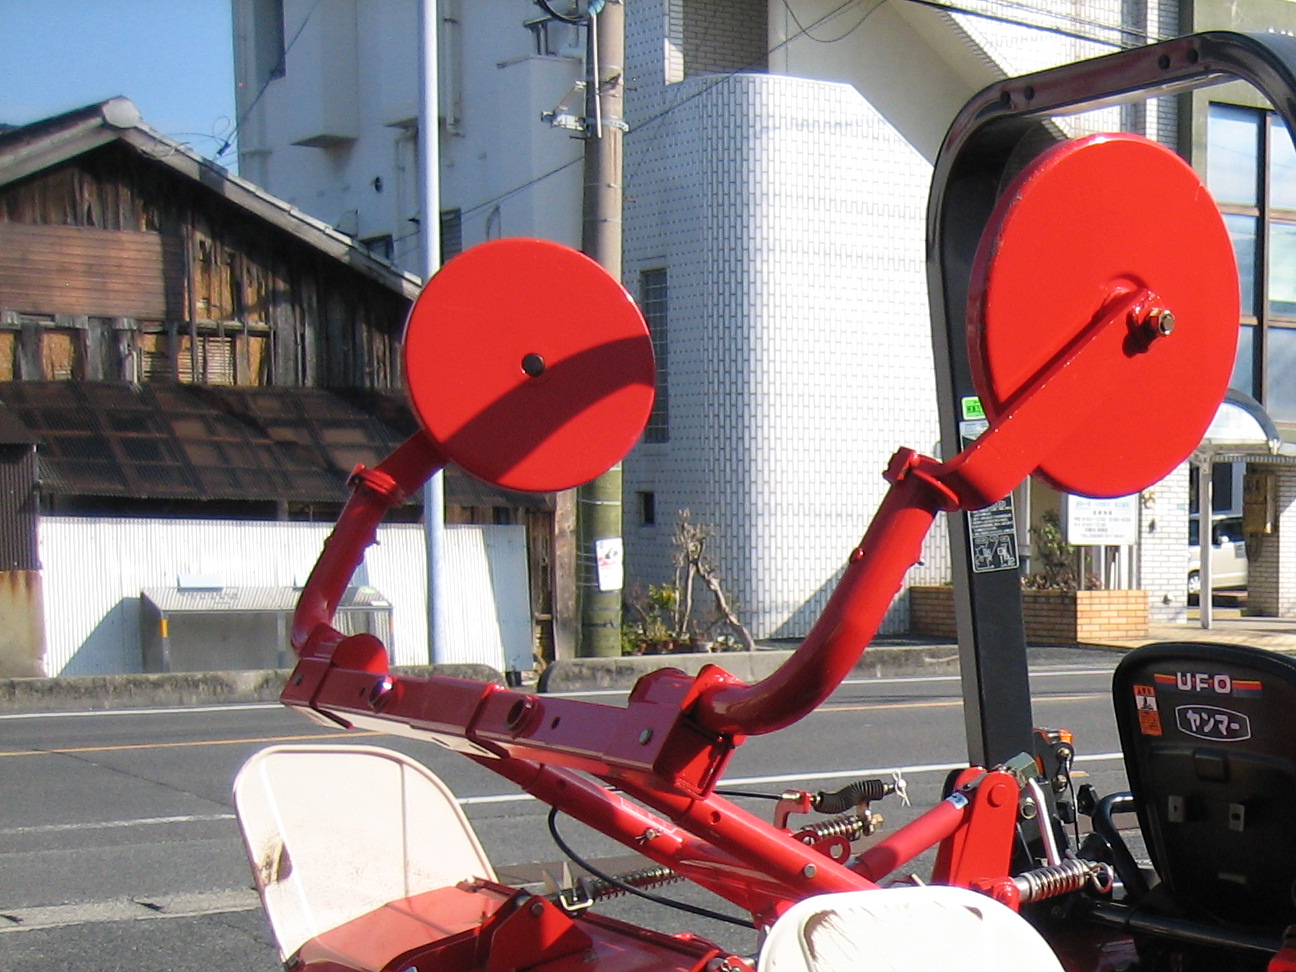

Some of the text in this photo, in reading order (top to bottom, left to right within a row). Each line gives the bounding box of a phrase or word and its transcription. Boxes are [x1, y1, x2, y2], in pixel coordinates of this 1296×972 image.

[1176, 672, 1231, 694] UFO
[1186, 709, 1240, 735] ヤンマー
